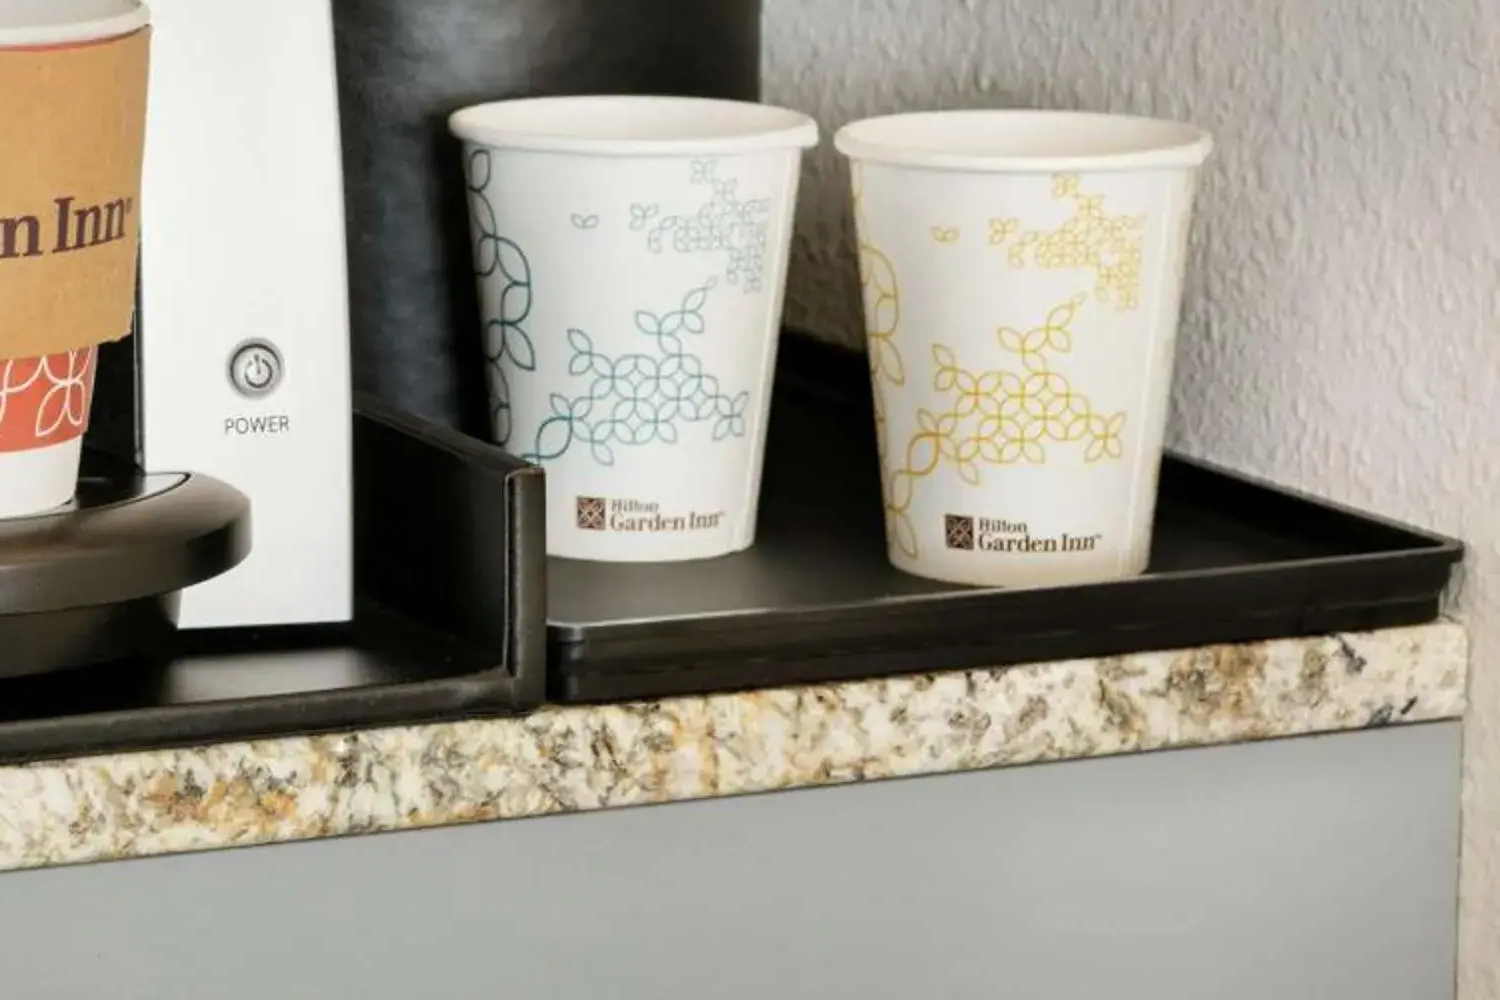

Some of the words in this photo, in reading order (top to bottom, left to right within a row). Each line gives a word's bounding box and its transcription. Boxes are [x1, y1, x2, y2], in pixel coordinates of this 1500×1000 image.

[51, 196, 126, 254] Inn
[224, 415, 290, 434] POWER
[611, 498, 660, 513] Hilton
[609, 514, 685, 532] Garden
[978, 516, 1028, 533] Hilton
[978, 531, 1057, 553] Garden
